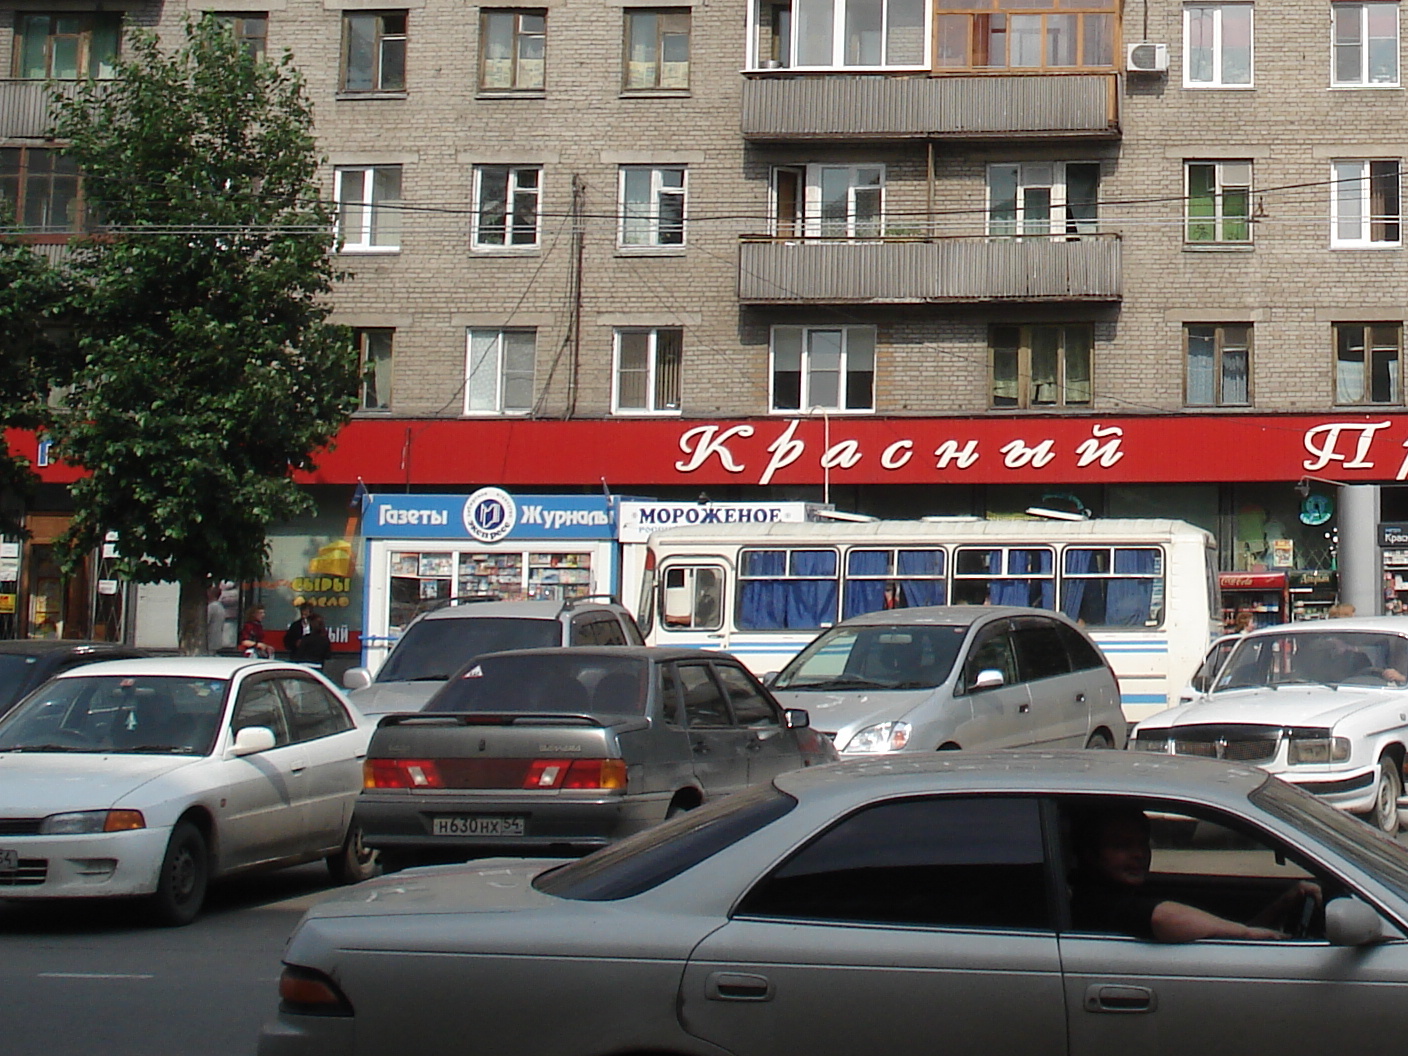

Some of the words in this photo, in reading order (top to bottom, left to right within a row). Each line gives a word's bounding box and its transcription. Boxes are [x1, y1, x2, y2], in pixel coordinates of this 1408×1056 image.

[674, 419, 1124, 485] Красный
[379, 504, 448, 526] Газеты
[520, 505, 614, 529] Журналы
[639, 508, 782, 524] МОРОЖЕНОЕ
[291, 577, 351, 592] СЫРЫ
[503, 818, 520, 829] 54
